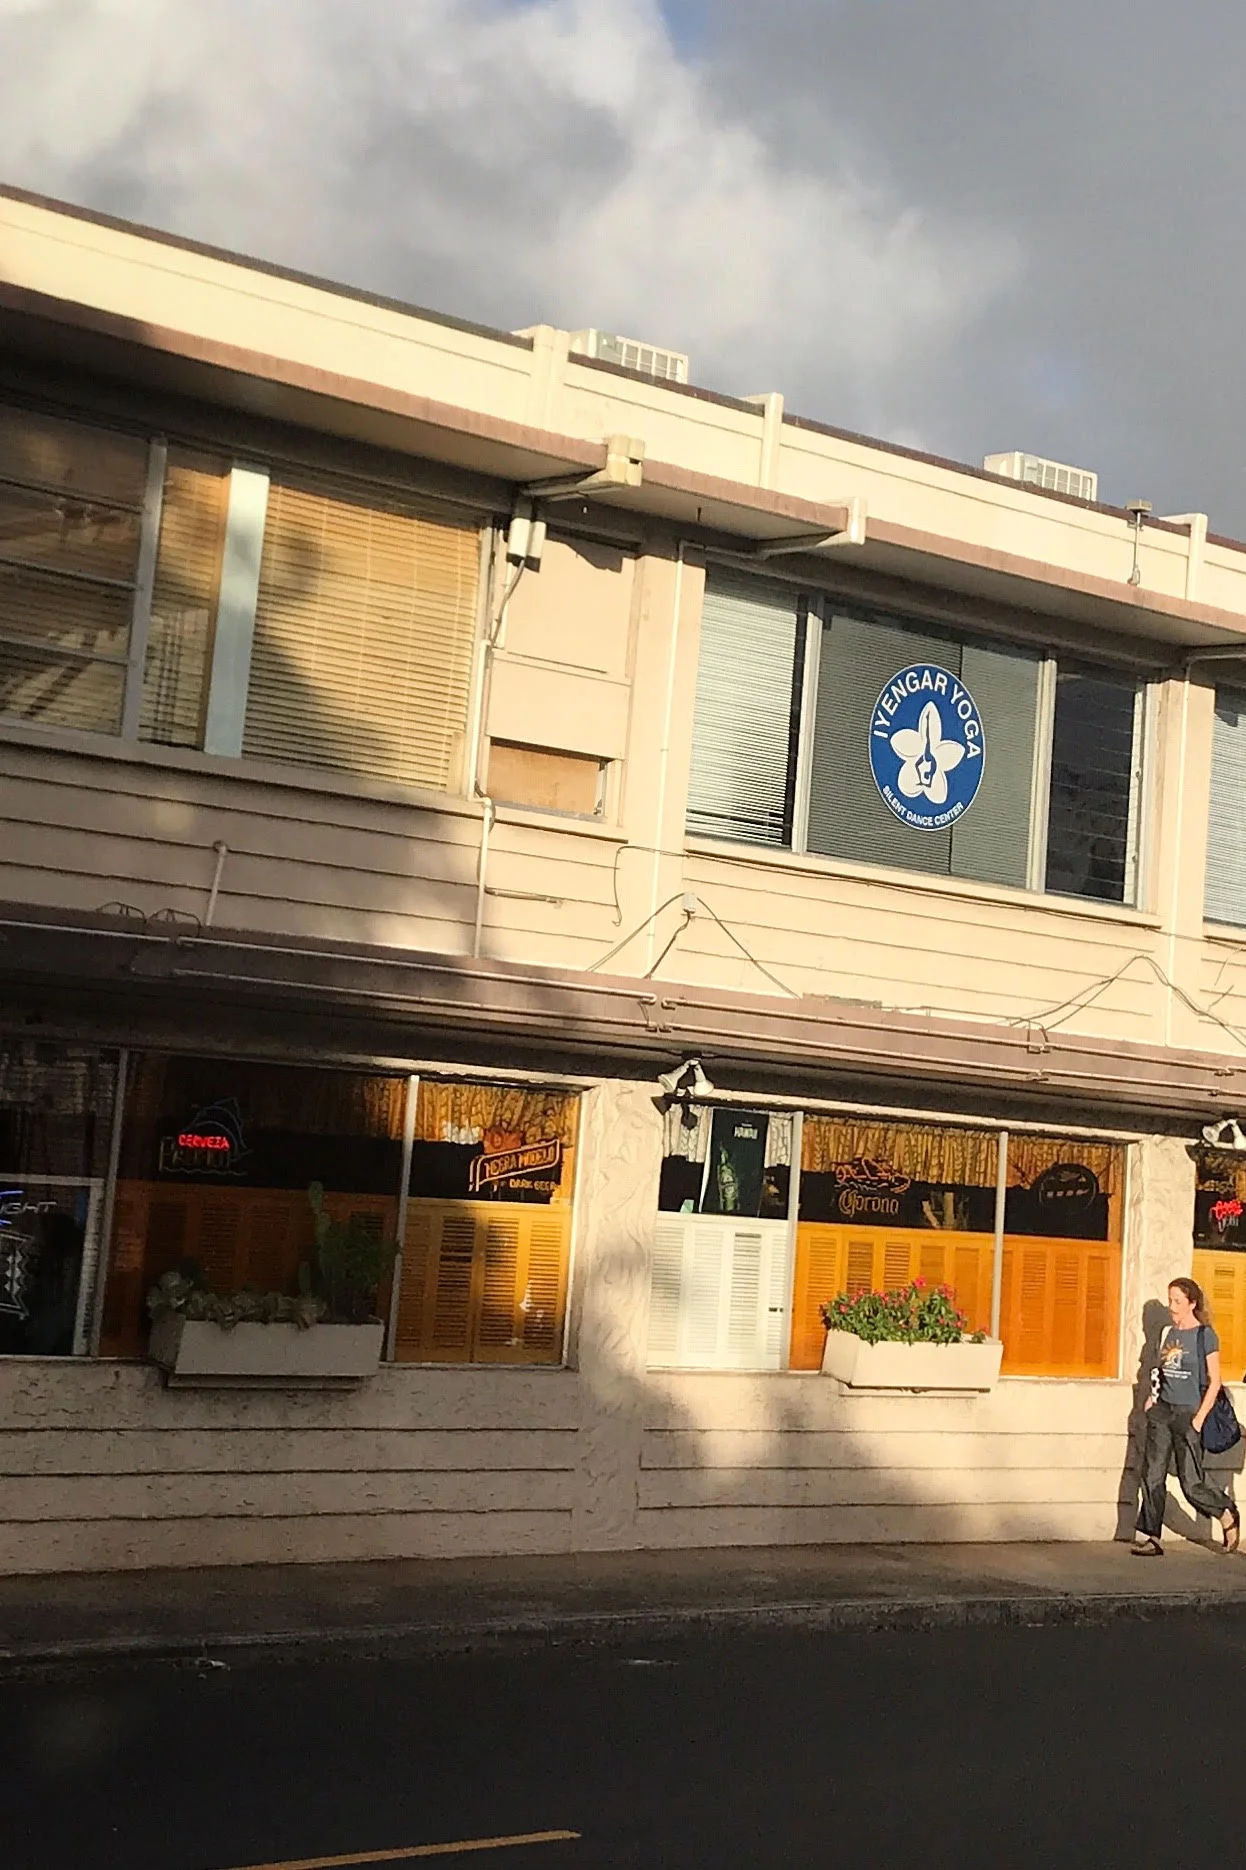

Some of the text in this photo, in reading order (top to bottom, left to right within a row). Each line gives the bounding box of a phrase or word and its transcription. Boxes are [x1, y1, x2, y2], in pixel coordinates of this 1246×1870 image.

[873, 669, 981, 759] IYENGAR YOGA
[882, 785, 965, 826] SILENT DANCE CENTER
[178, 1133, 231, 1150] CERVEZA
[838, 1189, 899, 1218] Corona
